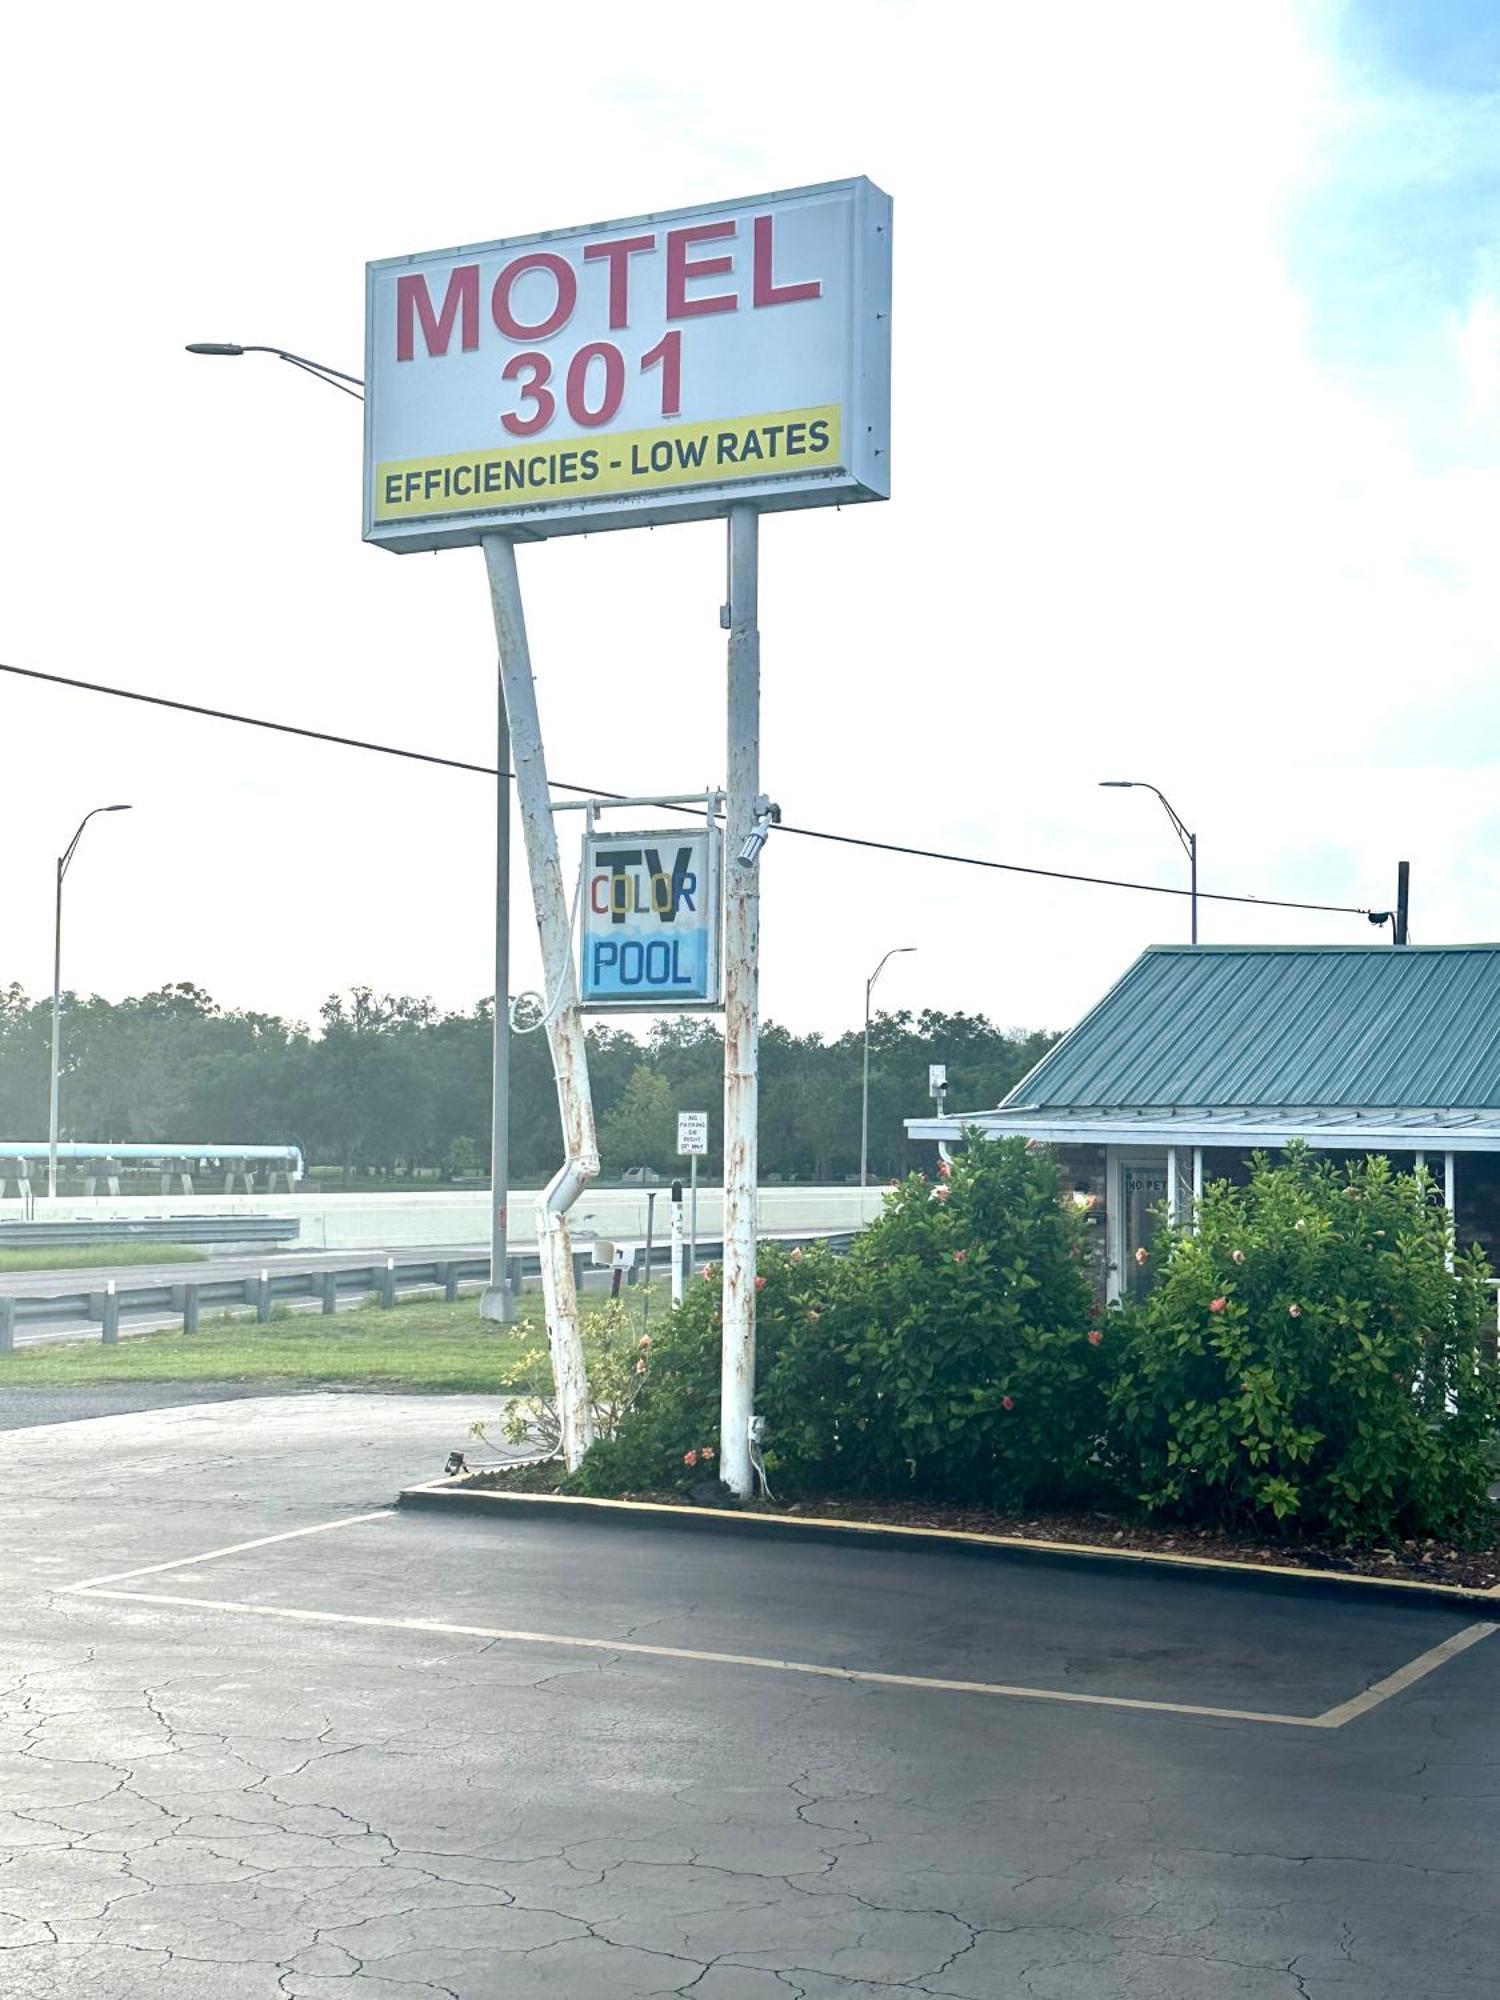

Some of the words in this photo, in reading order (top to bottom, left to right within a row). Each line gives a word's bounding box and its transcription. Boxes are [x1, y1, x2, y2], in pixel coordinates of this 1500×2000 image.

[396, 214, 822, 362] MOTEL
[499, 329, 683, 436] 301
[385, 449, 600, 504] EFFICIENCIES
[631, 436, 709, 475] LOW
[717, 420, 830, 465] RATES
[591, 872, 697, 914] COLOR
[595, 847, 693, 924] TV
[594, 940, 692, 986] POOL
[1130, 1180, 1143, 1191] NO
